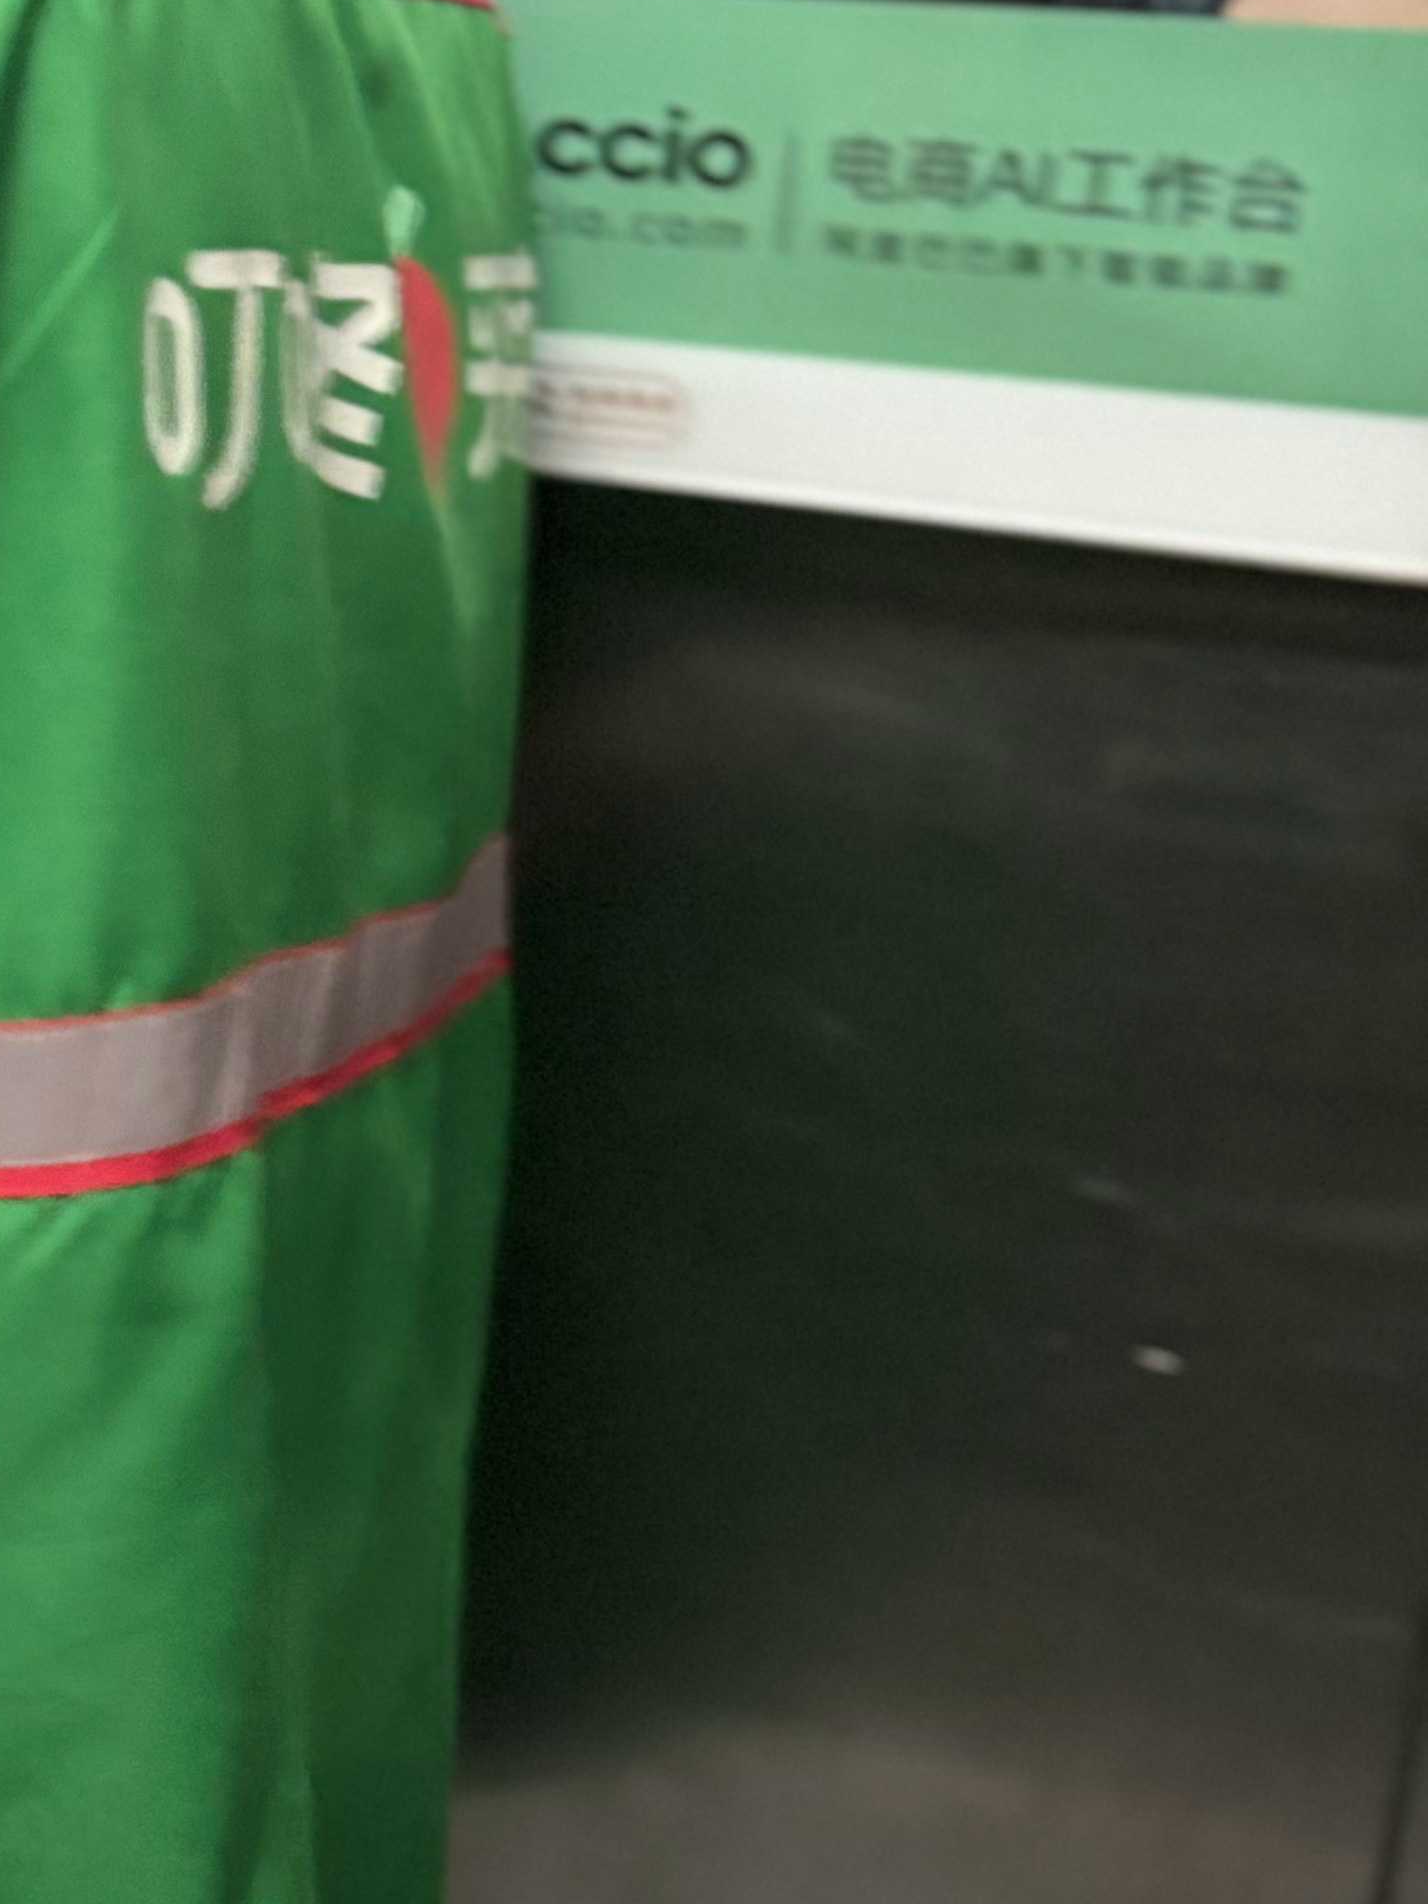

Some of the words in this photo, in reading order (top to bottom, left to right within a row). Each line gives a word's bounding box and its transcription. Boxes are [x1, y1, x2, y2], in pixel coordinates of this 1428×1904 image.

[827, 130, 1311, 237] 电商AI工作台
